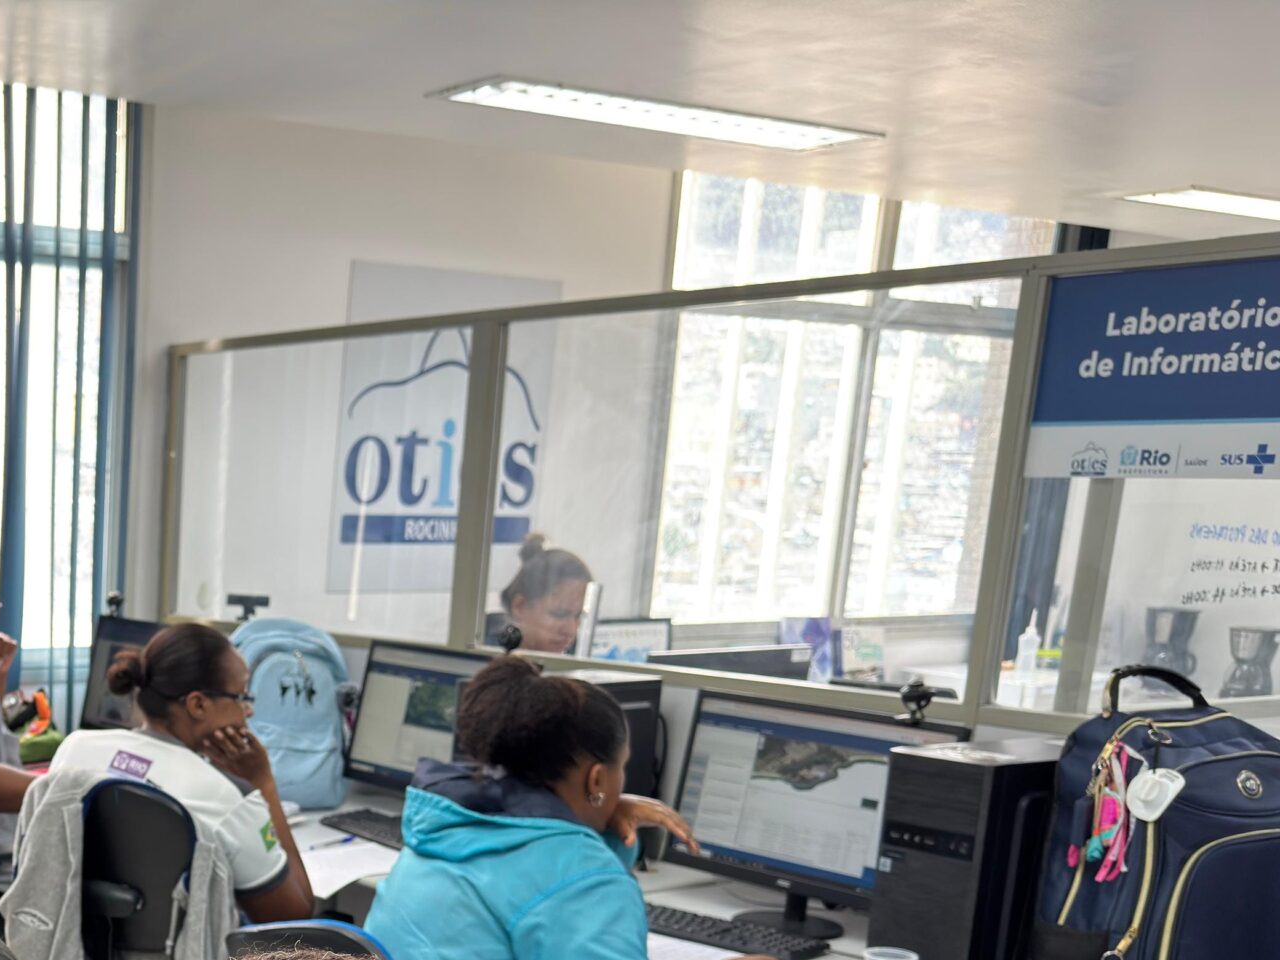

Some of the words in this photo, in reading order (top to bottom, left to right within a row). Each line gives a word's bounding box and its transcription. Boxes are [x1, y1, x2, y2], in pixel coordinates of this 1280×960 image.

[1105, 297, 1280, 337] Laboratório
[1078, 350, 1114, 378] de
[1122, 341, 1280, 376] Informátic
[345, 418, 537, 510] otis
[1139, 448, 1171, 466] Rio
[1220, 453, 1244, 466] SUS
[404, 519, 458, 541] ROCIN
